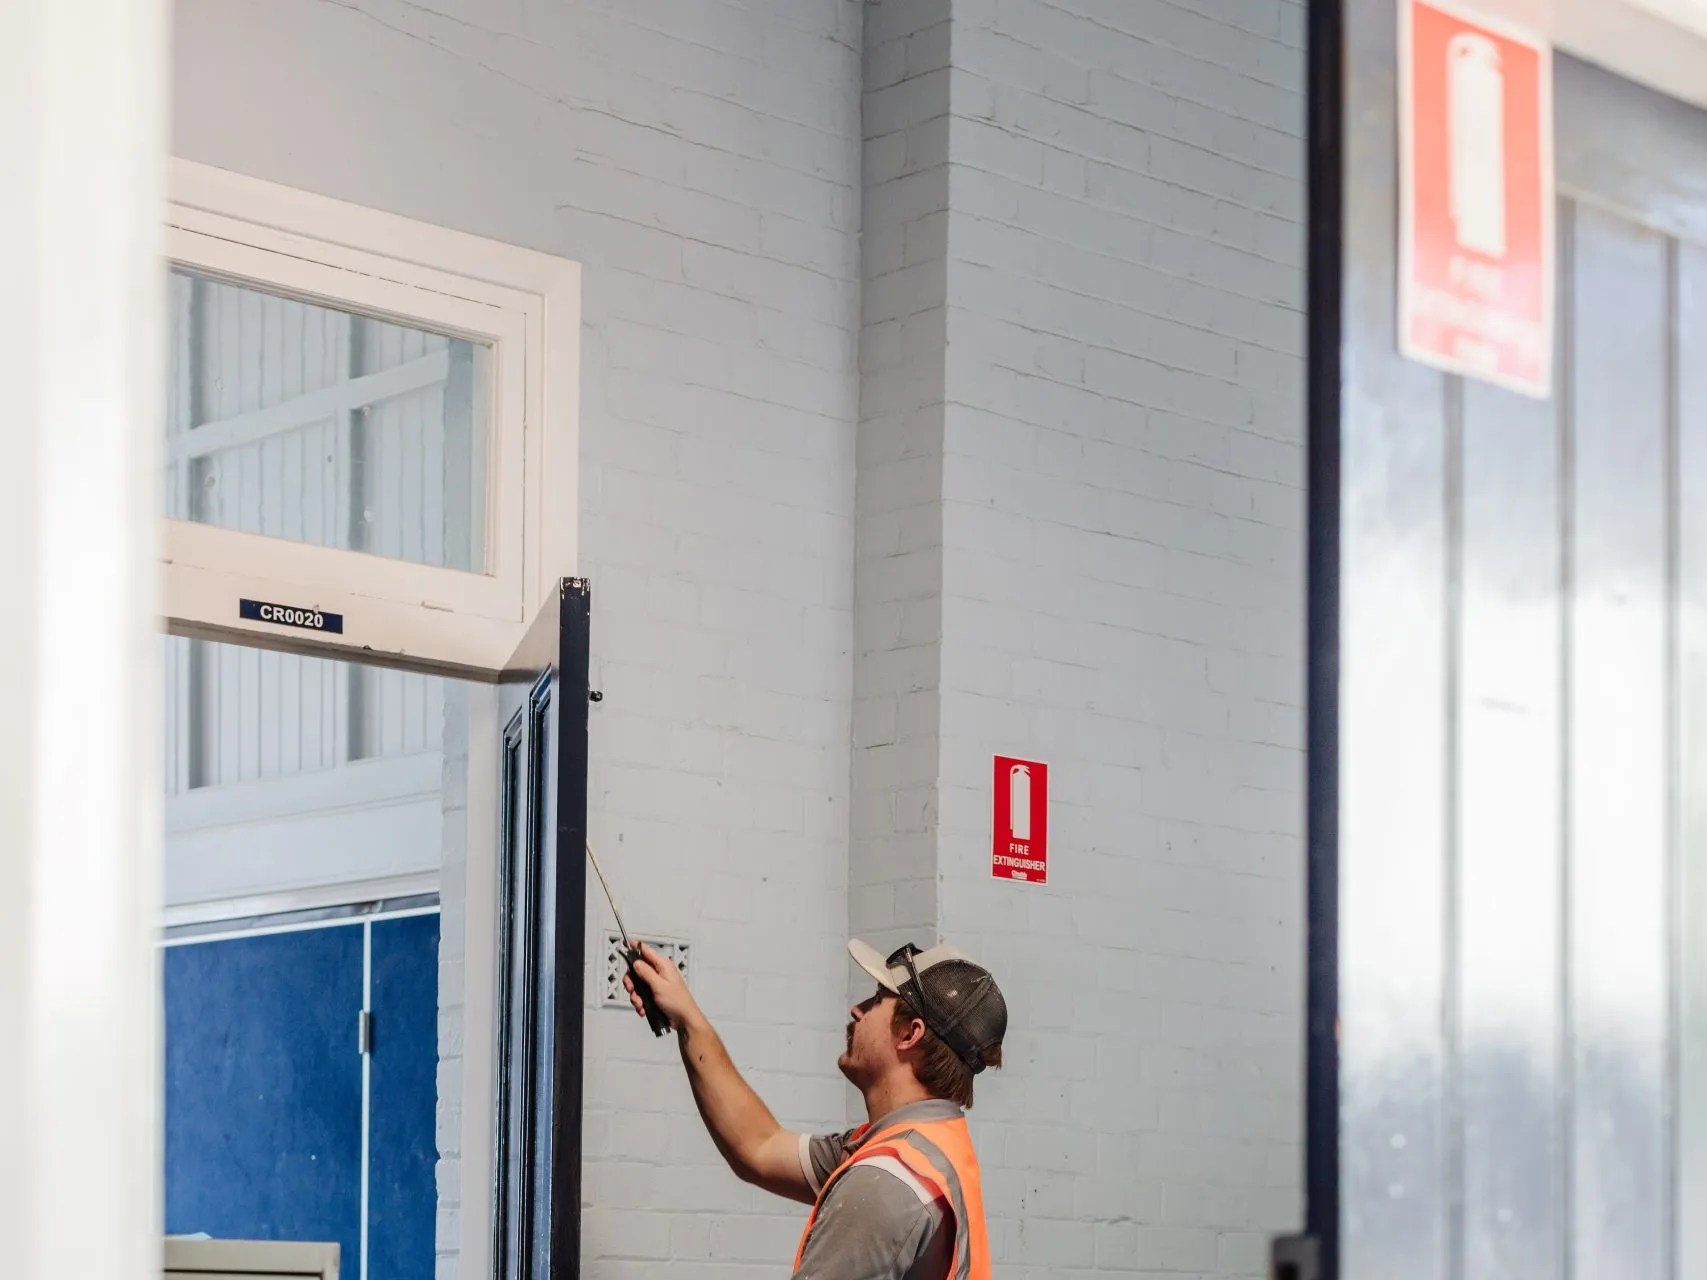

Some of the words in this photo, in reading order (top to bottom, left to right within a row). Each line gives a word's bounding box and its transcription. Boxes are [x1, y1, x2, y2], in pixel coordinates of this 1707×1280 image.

[260, 605, 324, 628] CR0020
[1009, 842, 1029, 855] FIRE
[993, 854, 1046, 872] EXTINGUISHER
